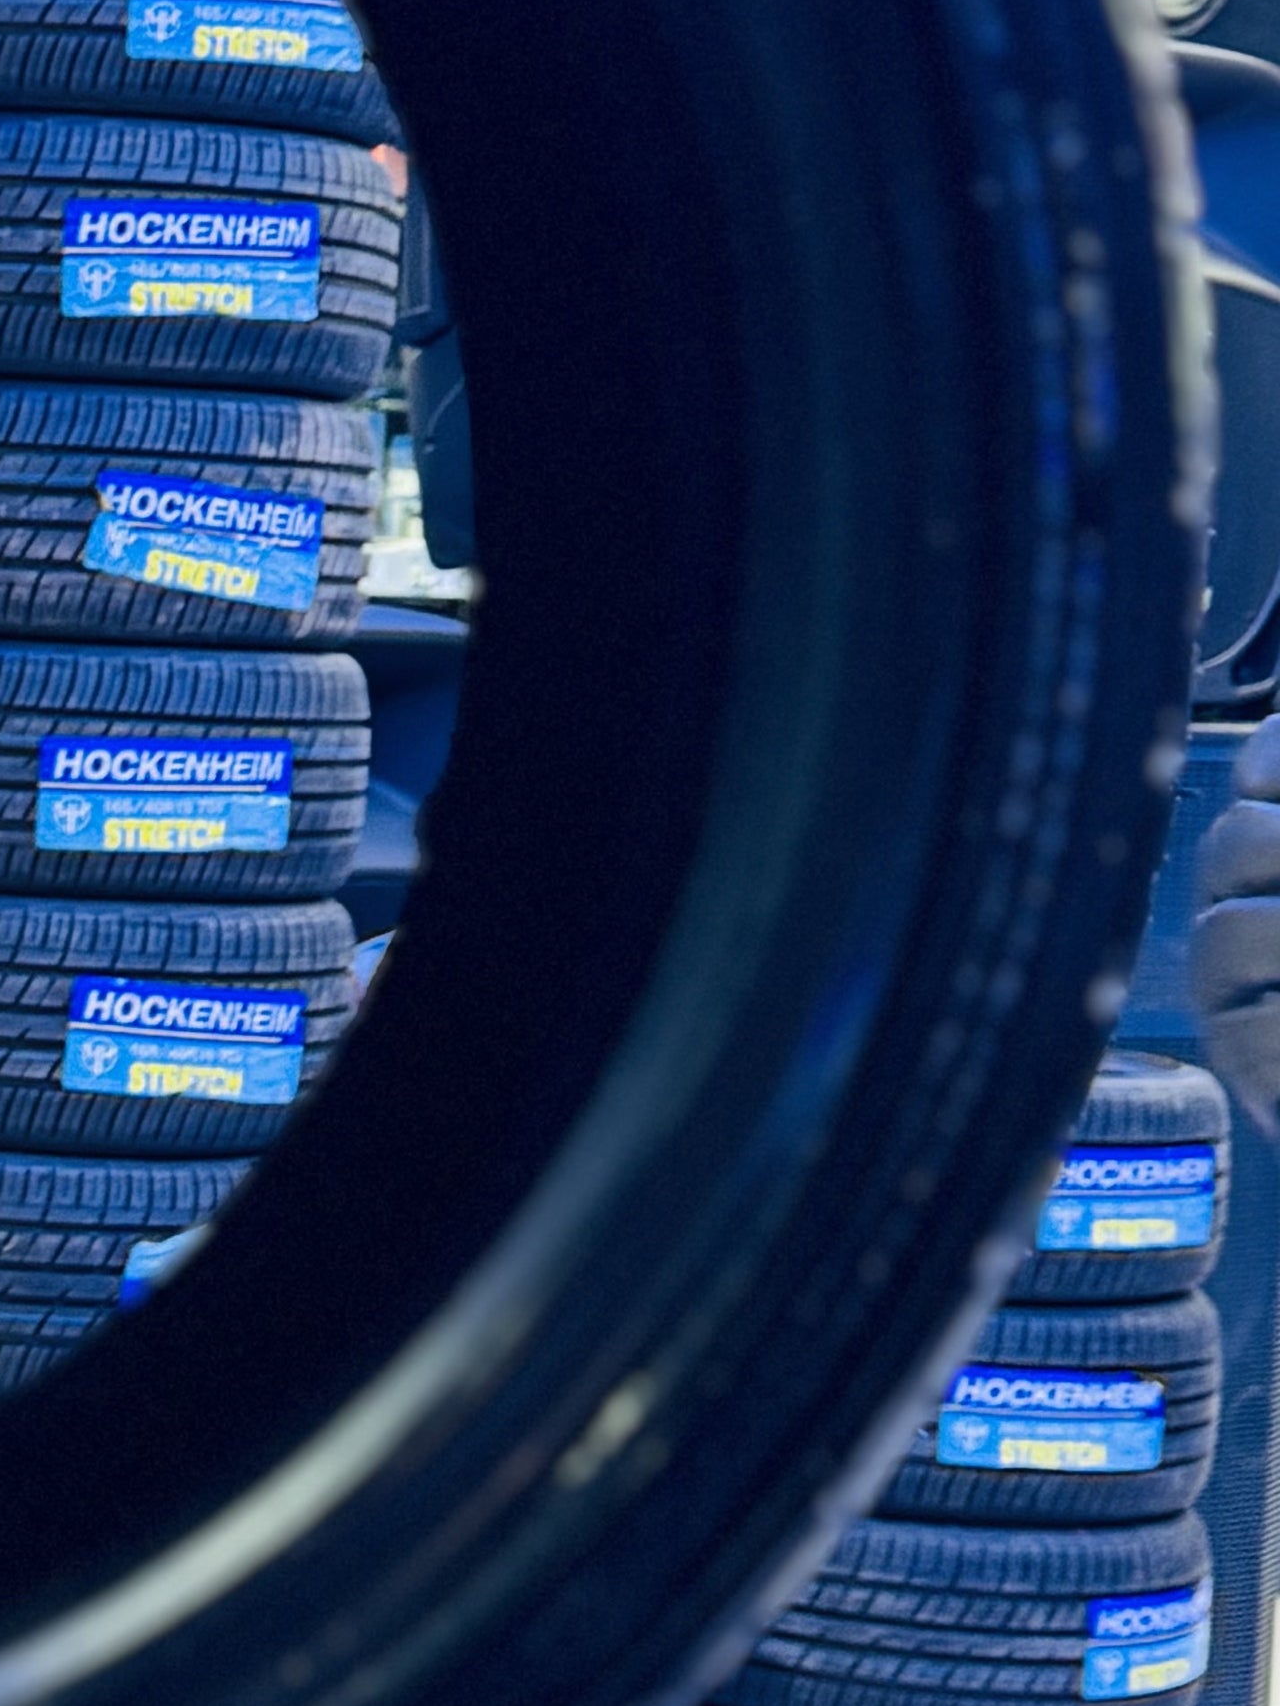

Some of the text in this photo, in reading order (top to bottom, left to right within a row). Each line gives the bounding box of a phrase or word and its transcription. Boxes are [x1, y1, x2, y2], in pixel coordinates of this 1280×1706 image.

[193, 25, 308, 62] STRETCH
[78, 213, 311, 248] HOCKENHEIM
[130, 281, 253, 314] STRETCH
[105, 483, 316, 540] HOCKENHEIM
[144, 549, 260, 597] STRETCH
[53, 749, 285, 781] HOCKENHEIM
[103, 818, 226, 850] STRETCH
[83, 990, 301, 1034] HOCKENHEIM
